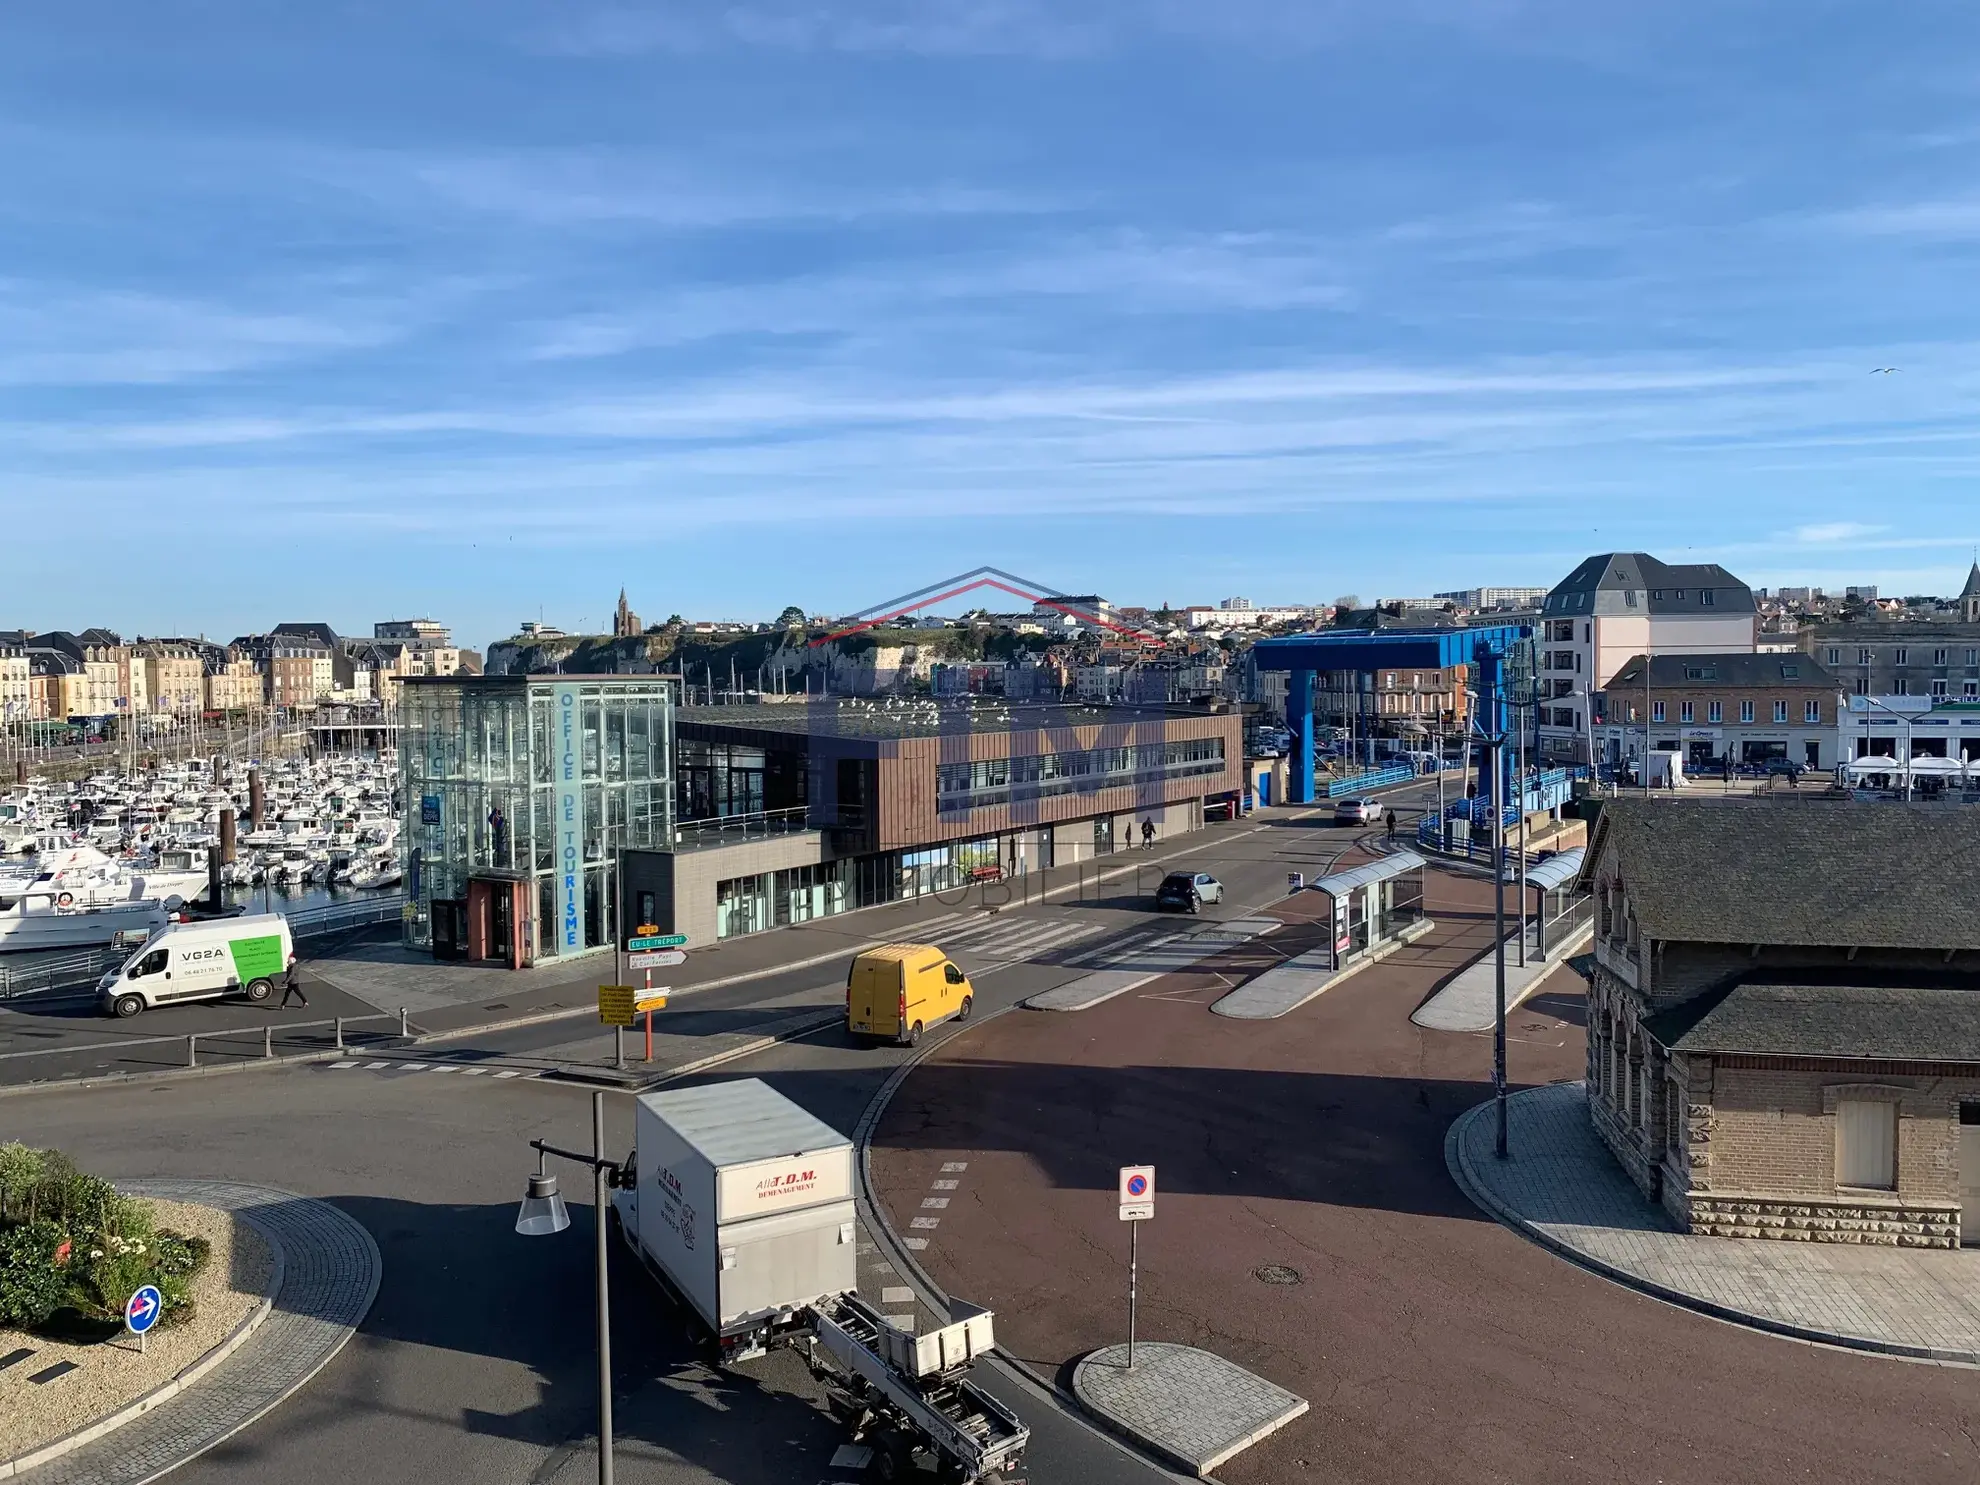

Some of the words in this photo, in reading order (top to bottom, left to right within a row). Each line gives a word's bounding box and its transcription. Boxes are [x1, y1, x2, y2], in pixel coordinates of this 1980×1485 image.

[561, 693, 573, 780] OFFICE
[563, 794, 574, 821] DE
[564, 831, 577, 946] TOURISME
[182, 949, 224, 961] VG2A
